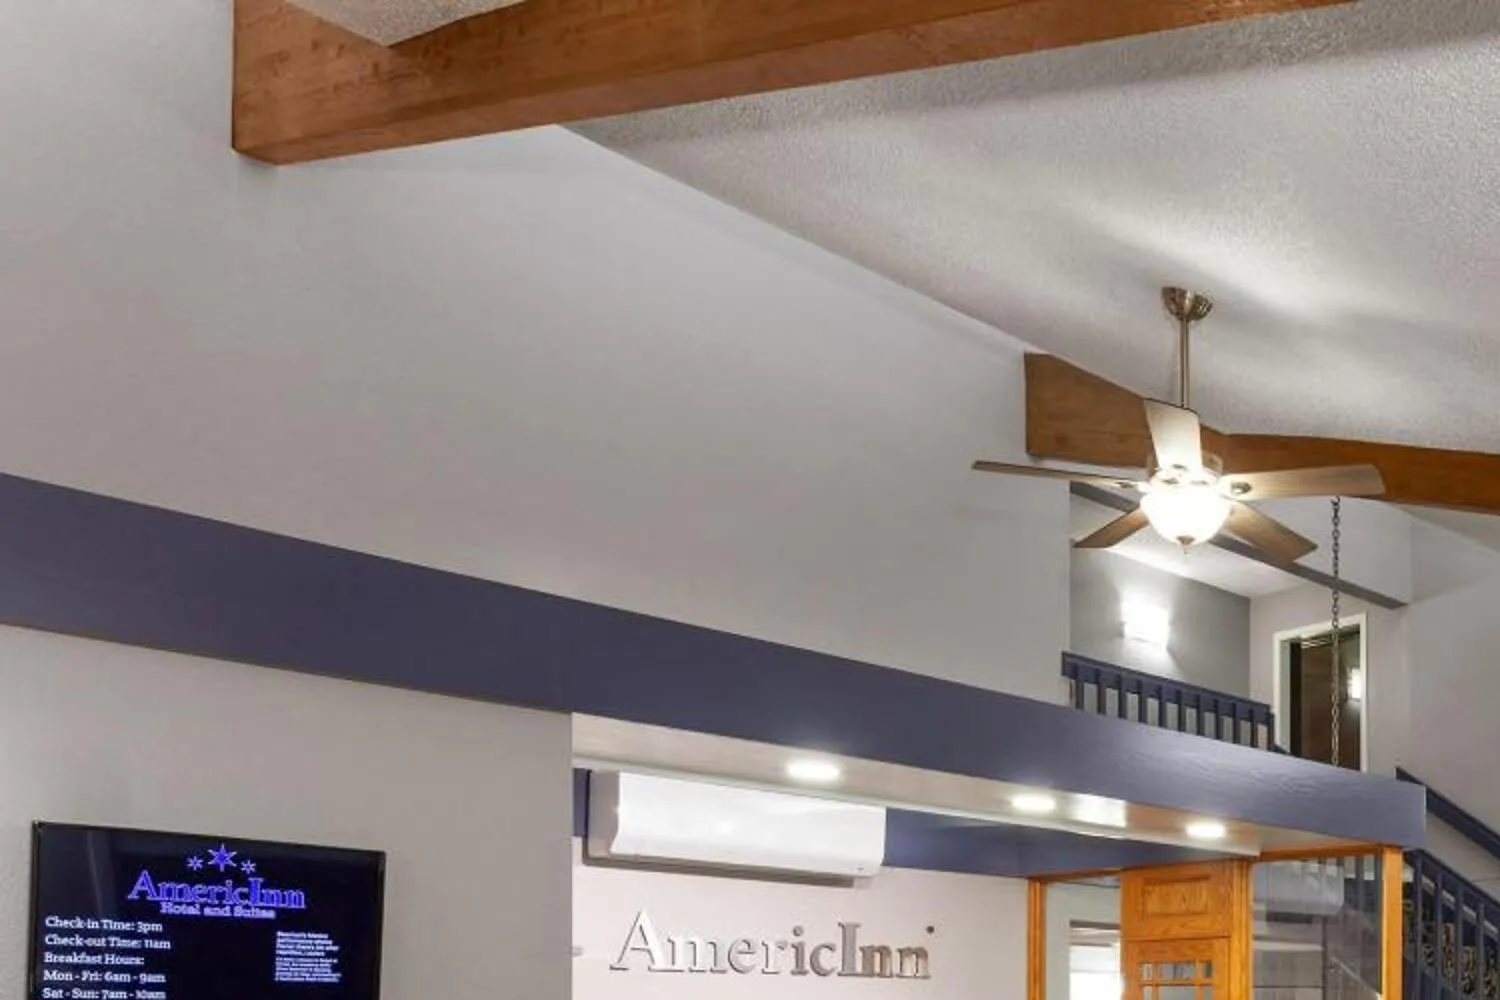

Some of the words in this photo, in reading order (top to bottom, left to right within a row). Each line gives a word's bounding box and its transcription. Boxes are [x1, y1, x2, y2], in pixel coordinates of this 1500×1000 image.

[128, 869, 306, 909] AmericInn
[160, 902, 201, 916] Hotel
[203, 905, 231, 917] and
[233, 906, 276, 919] Suites
[45, 916, 99, 929] Check-in
[101, 919, 135, 931] Time:
[137, 921, 163, 933] 3pm
[45, 934, 107, 947] Check-out
[108, 935, 142, 948] Time:
[144, 938, 171, 949] 11am
[609, 908, 932, 980] AmericInn
[44, 951, 102, 964] Breakfast
[104, 953, 145, 965] Hours:
[43, 970, 73, 981] Mon
[81, 970, 102, 981] Fri:
[104, 971, 131, 982] 6am
[139, 973, 167, 984] 9am
[42, 987, 64, 999] Sat
[72, 988, 99, 999] Sun:
[102, 989, 127, 1000] 7am
